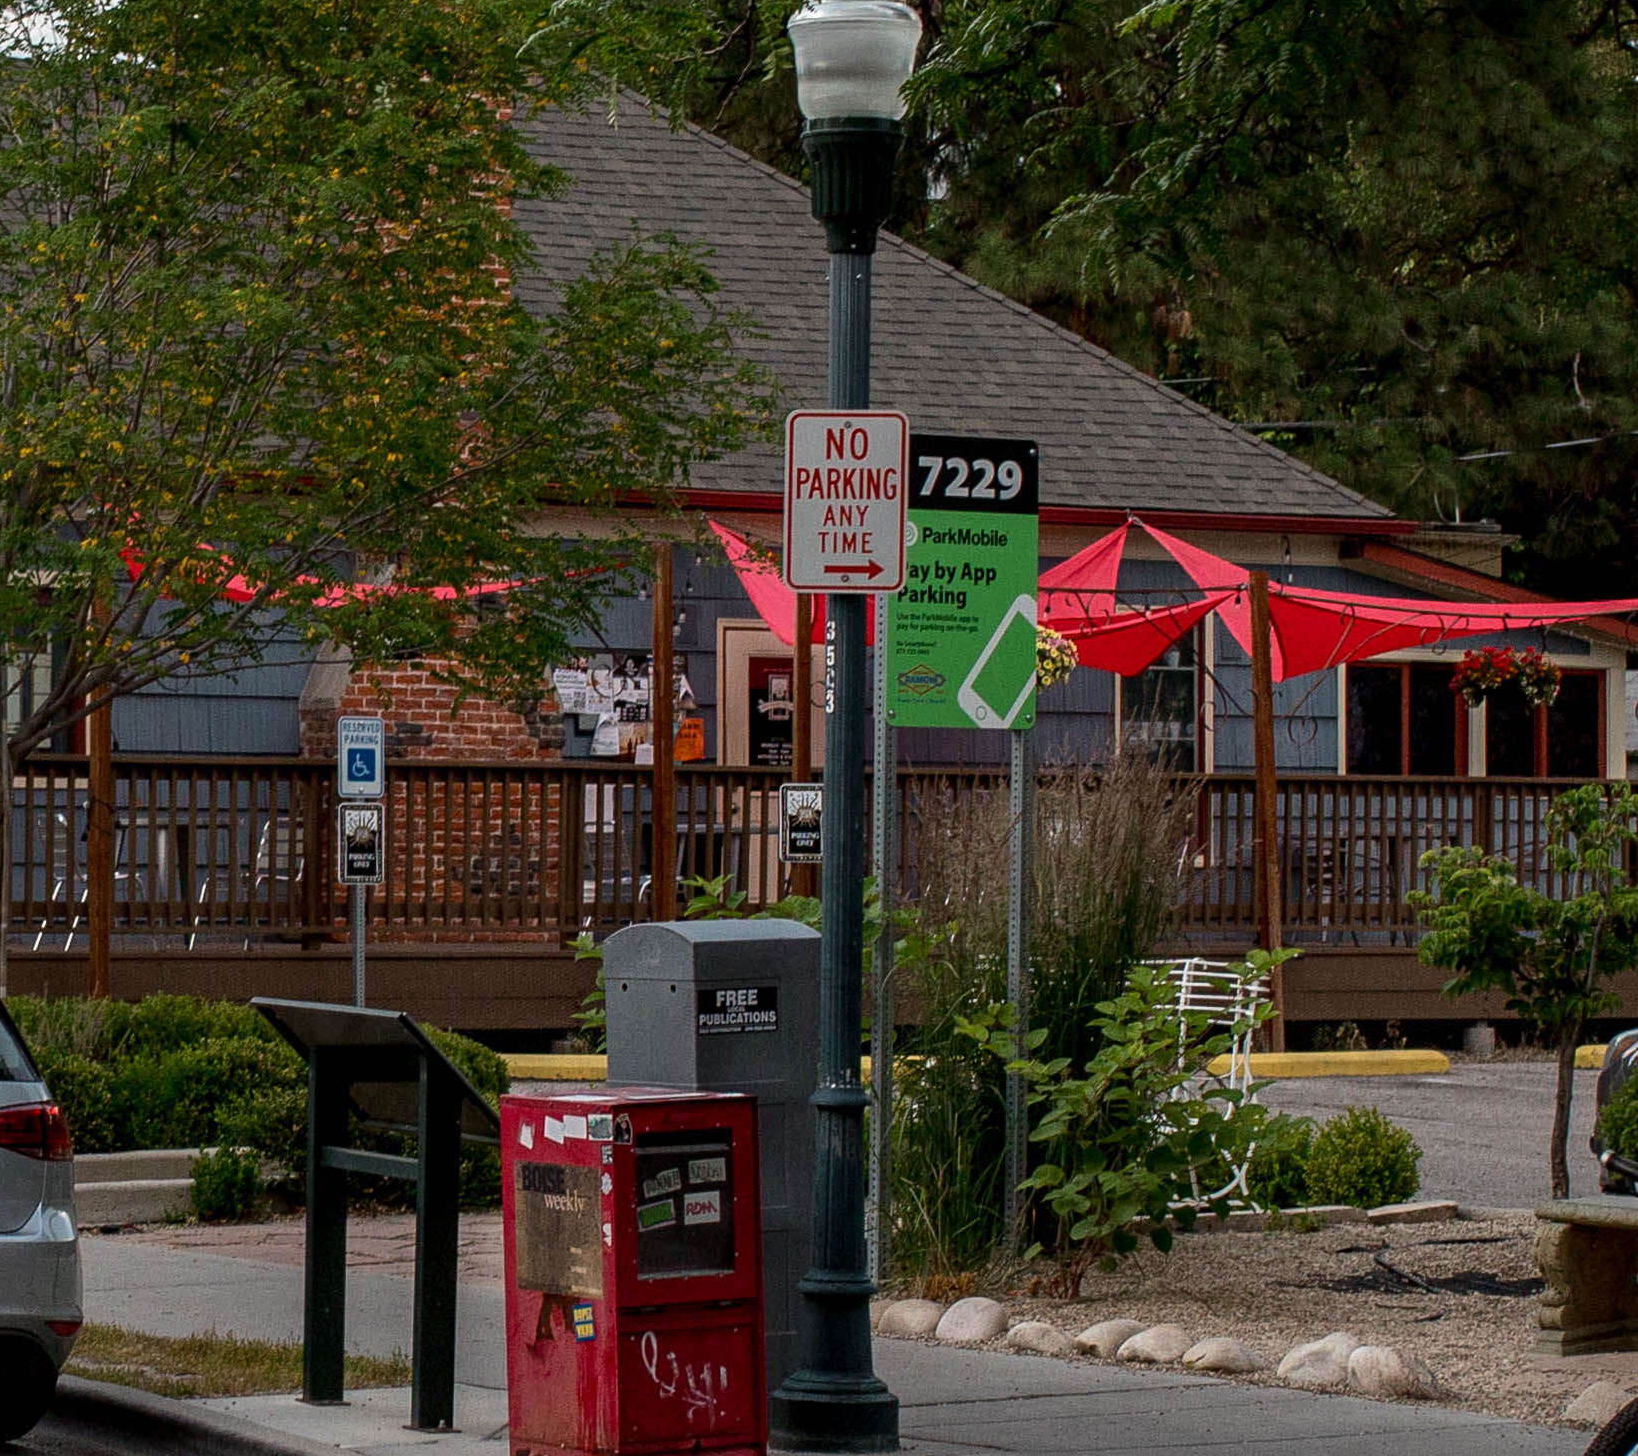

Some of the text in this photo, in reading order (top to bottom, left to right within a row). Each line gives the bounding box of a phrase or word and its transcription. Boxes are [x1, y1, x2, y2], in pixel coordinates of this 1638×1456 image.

[826, 428, 869, 461] NO
[795, 468, 898, 501] PARKING
[917, 456, 1023, 500] 7229
[823, 506, 869, 528] ANY
[818, 532, 874, 554] TIME
[922, 527, 1008, 546] ParkMobile
[906, 561, 997, 585] ay by App
[897, 585, 967, 609] Parking
[343, 723, 380, 733] RESERVED
[344, 734, 379, 745] PARKING
[716, 989, 758, 1007] FREE
[699, 1011, 776, 1025] PUBLICATIONS
[543, 1189, 586, 1218] weekly
